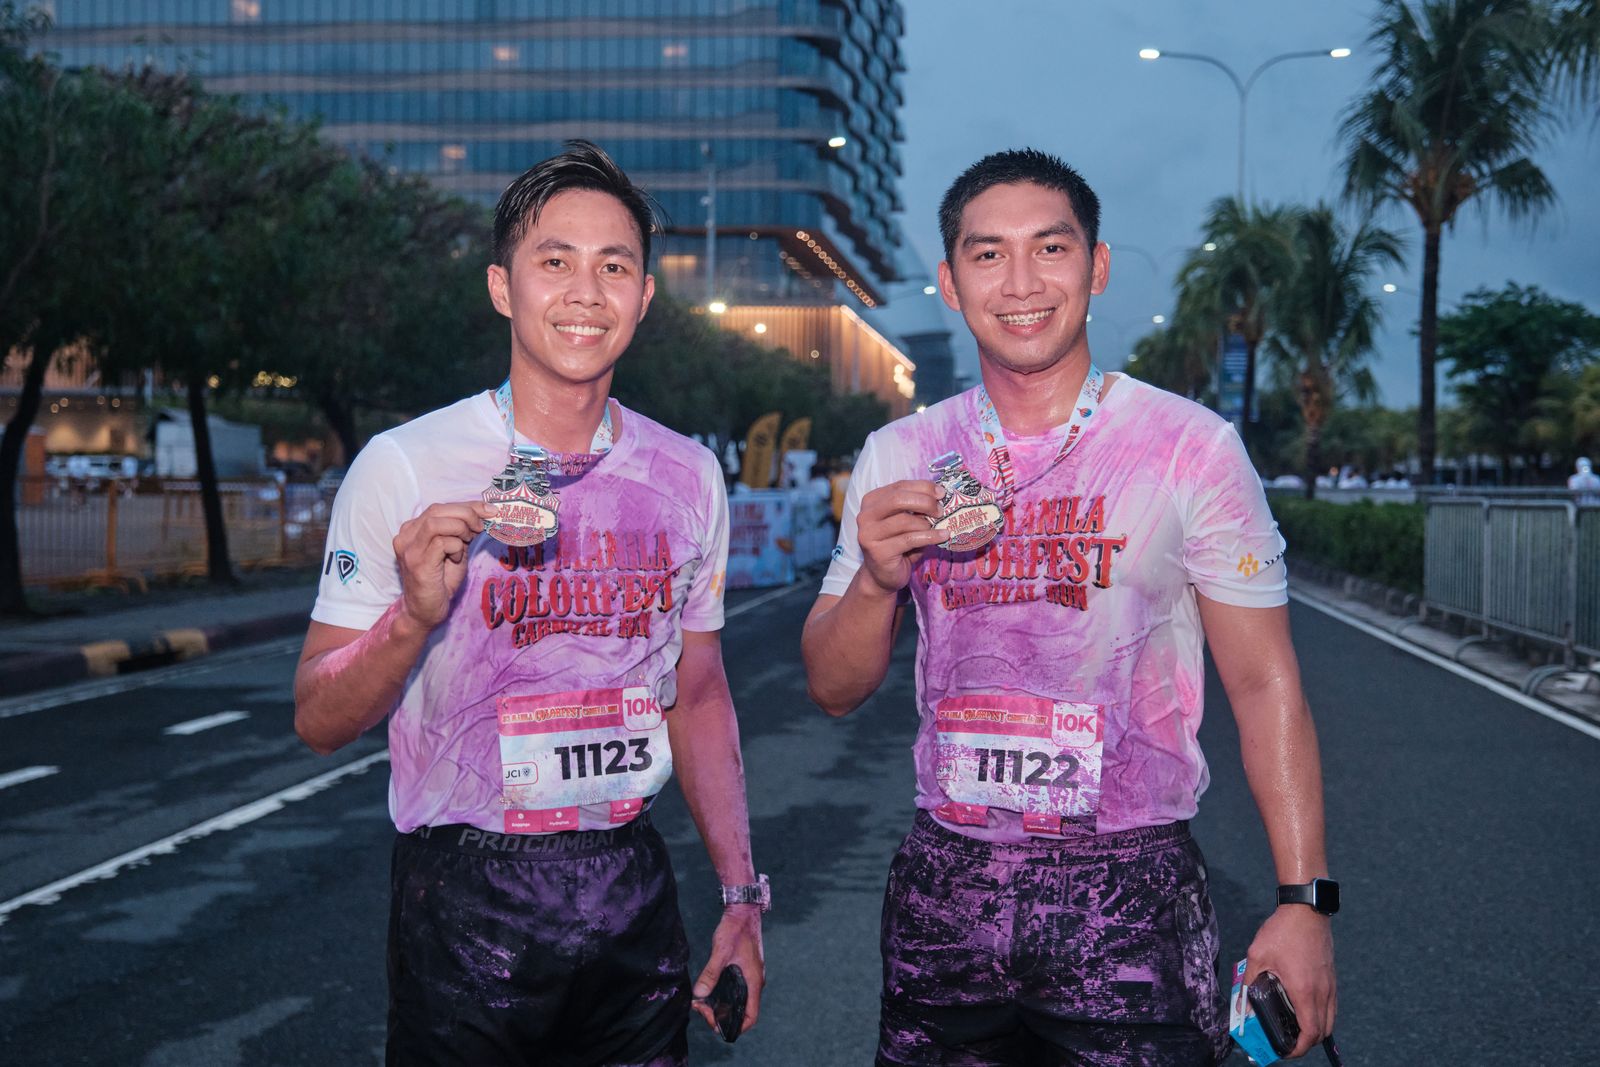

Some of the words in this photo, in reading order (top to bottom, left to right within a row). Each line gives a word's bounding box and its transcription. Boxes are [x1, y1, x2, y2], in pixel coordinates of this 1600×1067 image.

[554, 529, 673, 572] MANILA
[481, 570, 679, 630] COLORFEST
[941, 584, 1041, 611] CARNIVAL
[1046, 583, 1089, 612] RUN
[511, 619, 613, 649] CARNIVAL
[624, 698, 660, 717] 10K
[1055, 713, 1096, 734] 10K
[505, 769, 521, 779] JCI
[554, 738, 653, 780] 11123
[975, 748, 1080, 789] 11122
